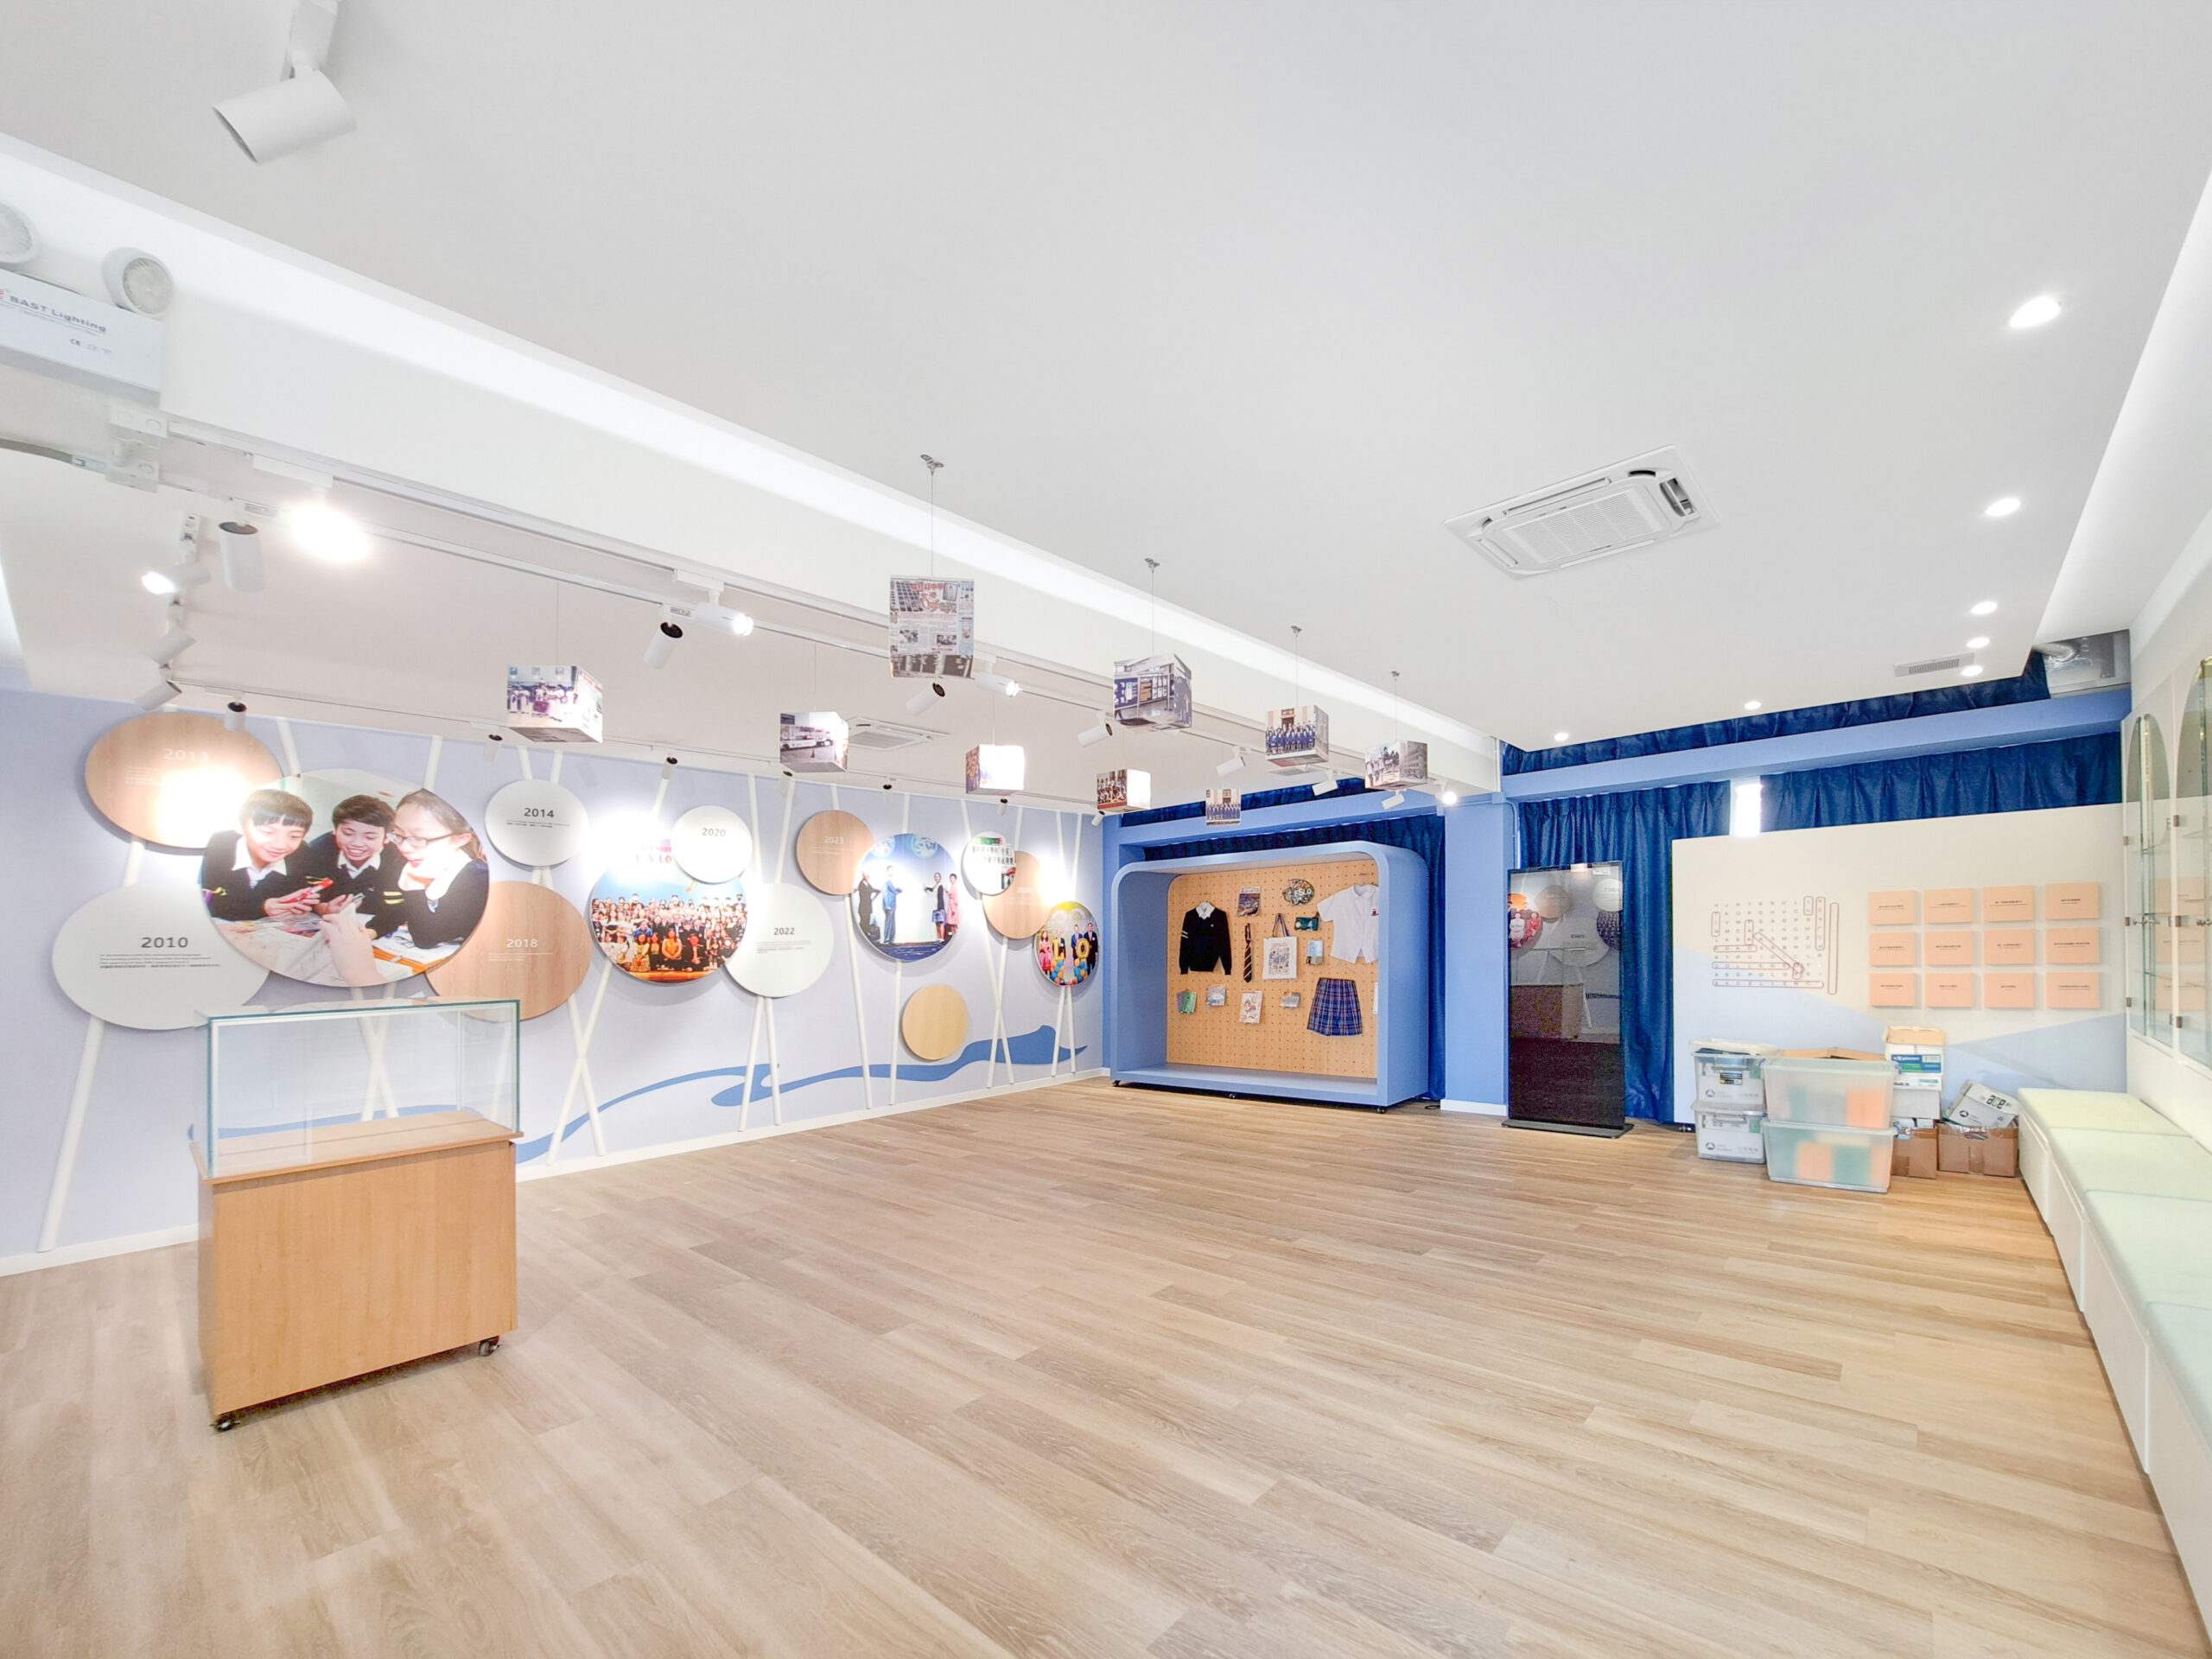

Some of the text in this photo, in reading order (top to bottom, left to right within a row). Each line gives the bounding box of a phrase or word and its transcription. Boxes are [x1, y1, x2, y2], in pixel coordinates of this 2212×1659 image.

[10, 296, 48, 312] BAST
[52, 309, 106, 333] Lighting
[163, 749, 209, 763] 2013
[524, 807, 555, 818] 2014
[702, 828, 726, 836] 2020
[824, 836, 844, 844] 2023
[773, 927, 795, 936] 2022
[141, 937, 188, 948] 2010
[506, 938, 537, 949] 2018
[1986, 1094, 2006, 1109] ace
